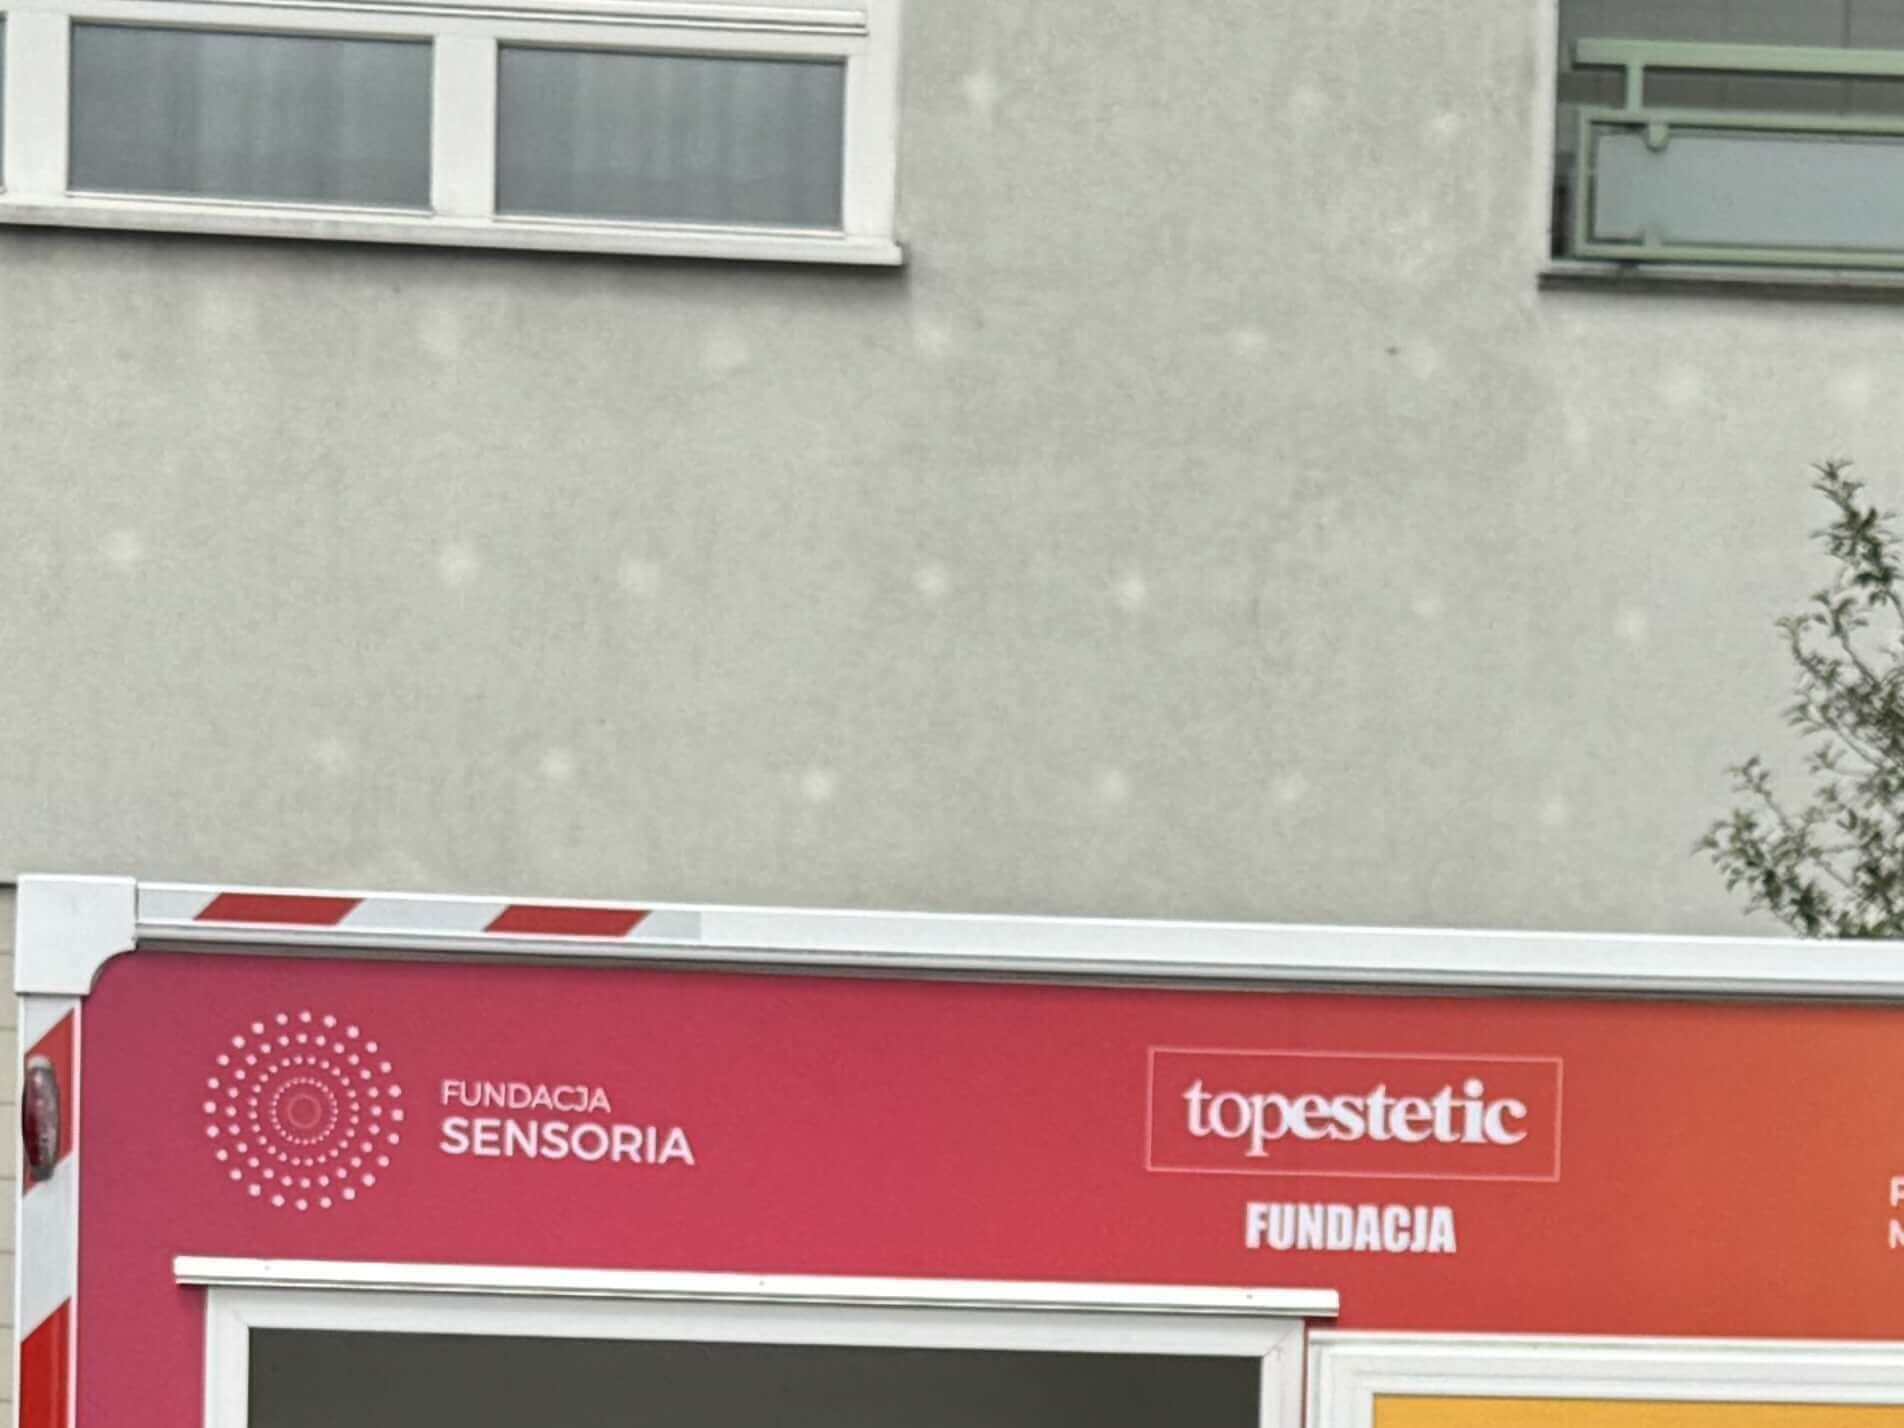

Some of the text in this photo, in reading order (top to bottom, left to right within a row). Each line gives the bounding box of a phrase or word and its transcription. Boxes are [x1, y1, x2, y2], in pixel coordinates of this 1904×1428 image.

[441, 1079, 612, 1113] FUNDACJA
[1182, 1077, 1528, 1158] topestetic
[440, 1116, 695, 1166] SENSORIA
[1244, 1202, 1457, 1254] FUNDACJA
